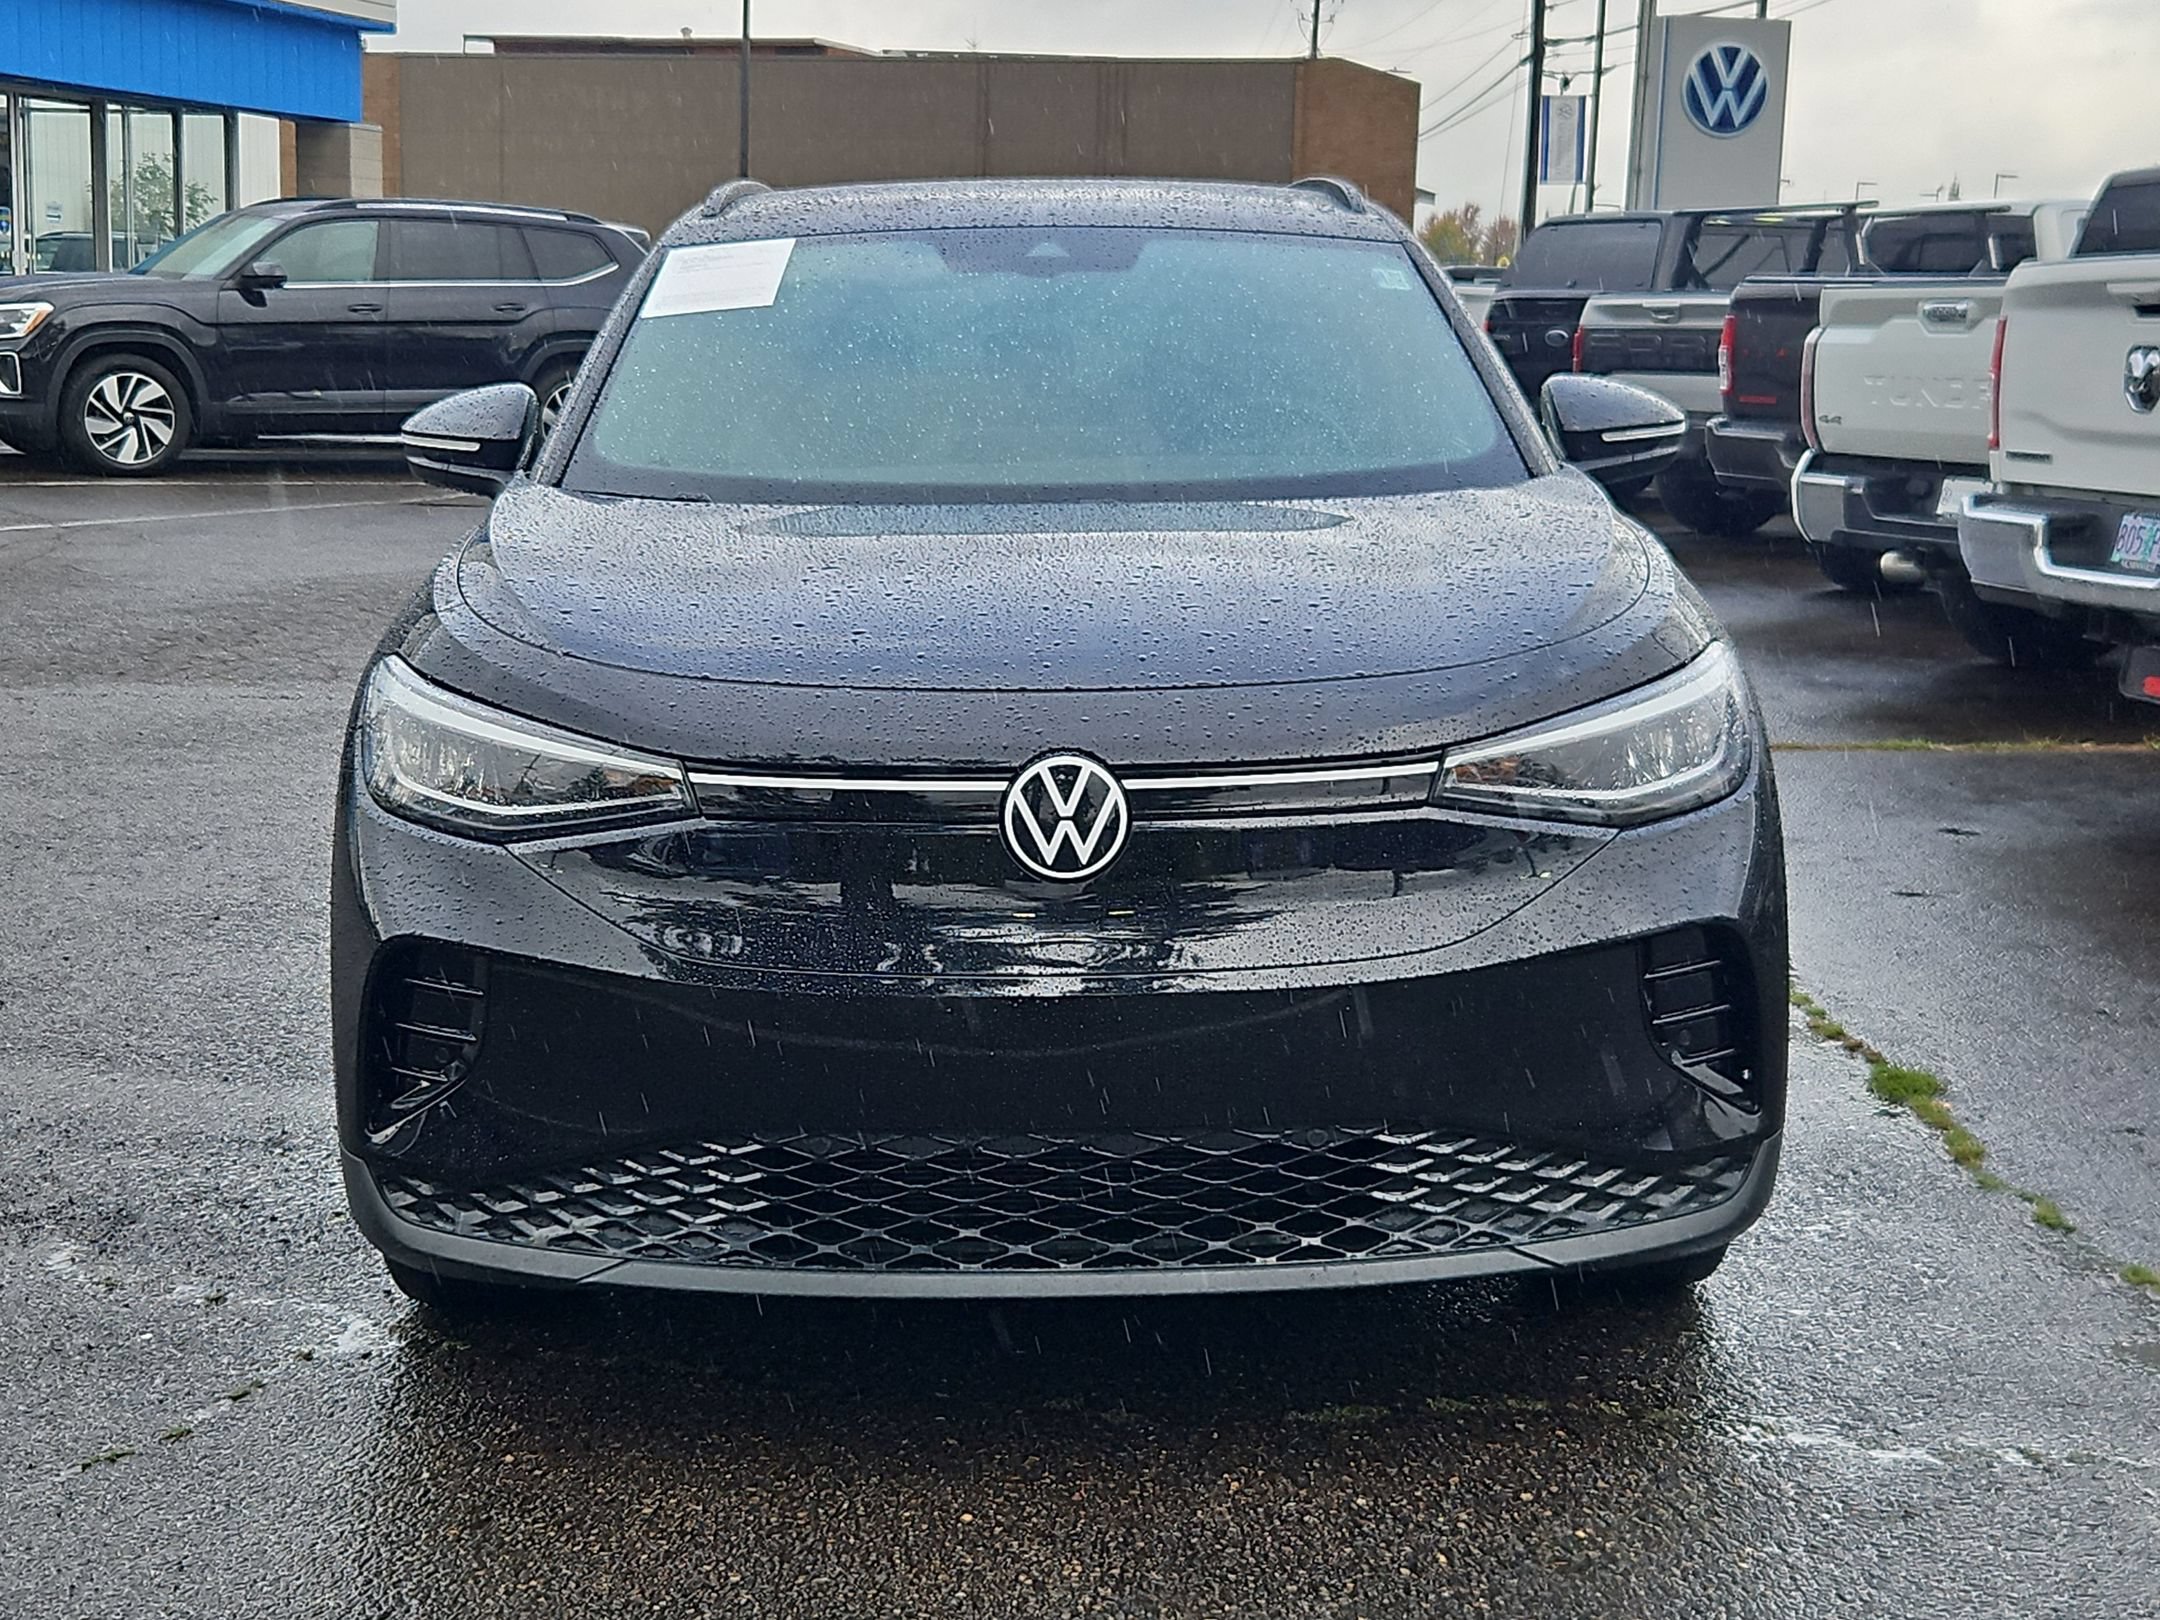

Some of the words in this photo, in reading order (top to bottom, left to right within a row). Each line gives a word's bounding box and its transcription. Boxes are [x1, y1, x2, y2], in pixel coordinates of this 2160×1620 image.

[1685, 42, 1767, 131] VW
[1863, 374, 1992, 410] TUNDR
[1008, 757, 1124, 872] VW
